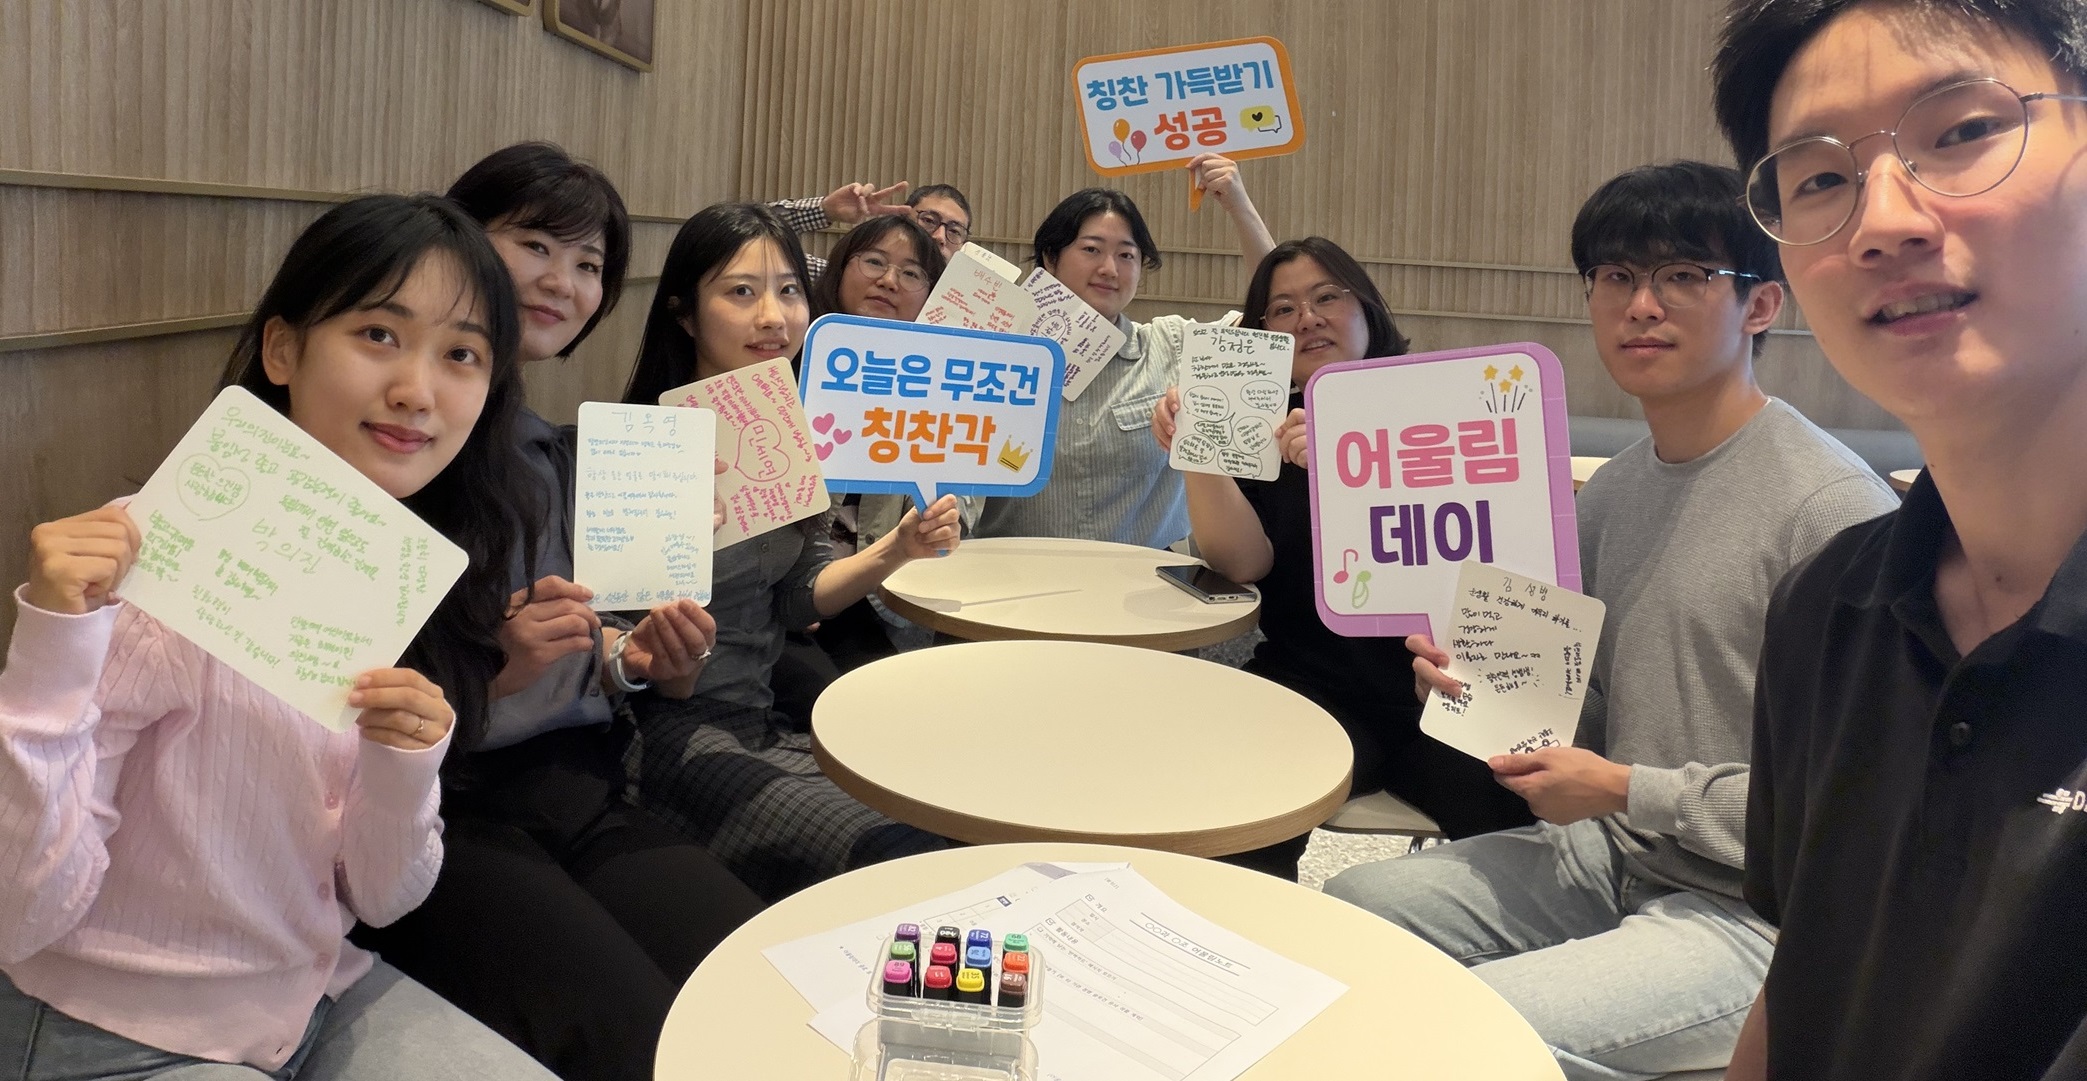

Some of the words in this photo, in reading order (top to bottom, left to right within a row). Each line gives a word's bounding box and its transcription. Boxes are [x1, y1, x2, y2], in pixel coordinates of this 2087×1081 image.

[1086, 76, 1149, 111] 칭찬
[1155, 60, 1274, 100] 가득받기
[1154, 107, 1228, 150] 성공
[974, 269, 1003, 292] 배수빈
[1211, 335, 1256, 354] 강정은
[821, 348, 932, 398] 오늘은
[941, 359, 1040, 406] 무조건
[749, 424, 777, 478] 민세연
[861, 407, 996, 466] 칭찬각
[1336, 418, 1519, 489] 어울림
[1370, 500, 1494, 566] 데이
[1461, 607, 1480, 619] 많이
[1482, 611, 1503, 621] 먹고
[1056, 927, 1078, 944] 활동내용
[1190, 947, 1234, 969] 어울림노트
